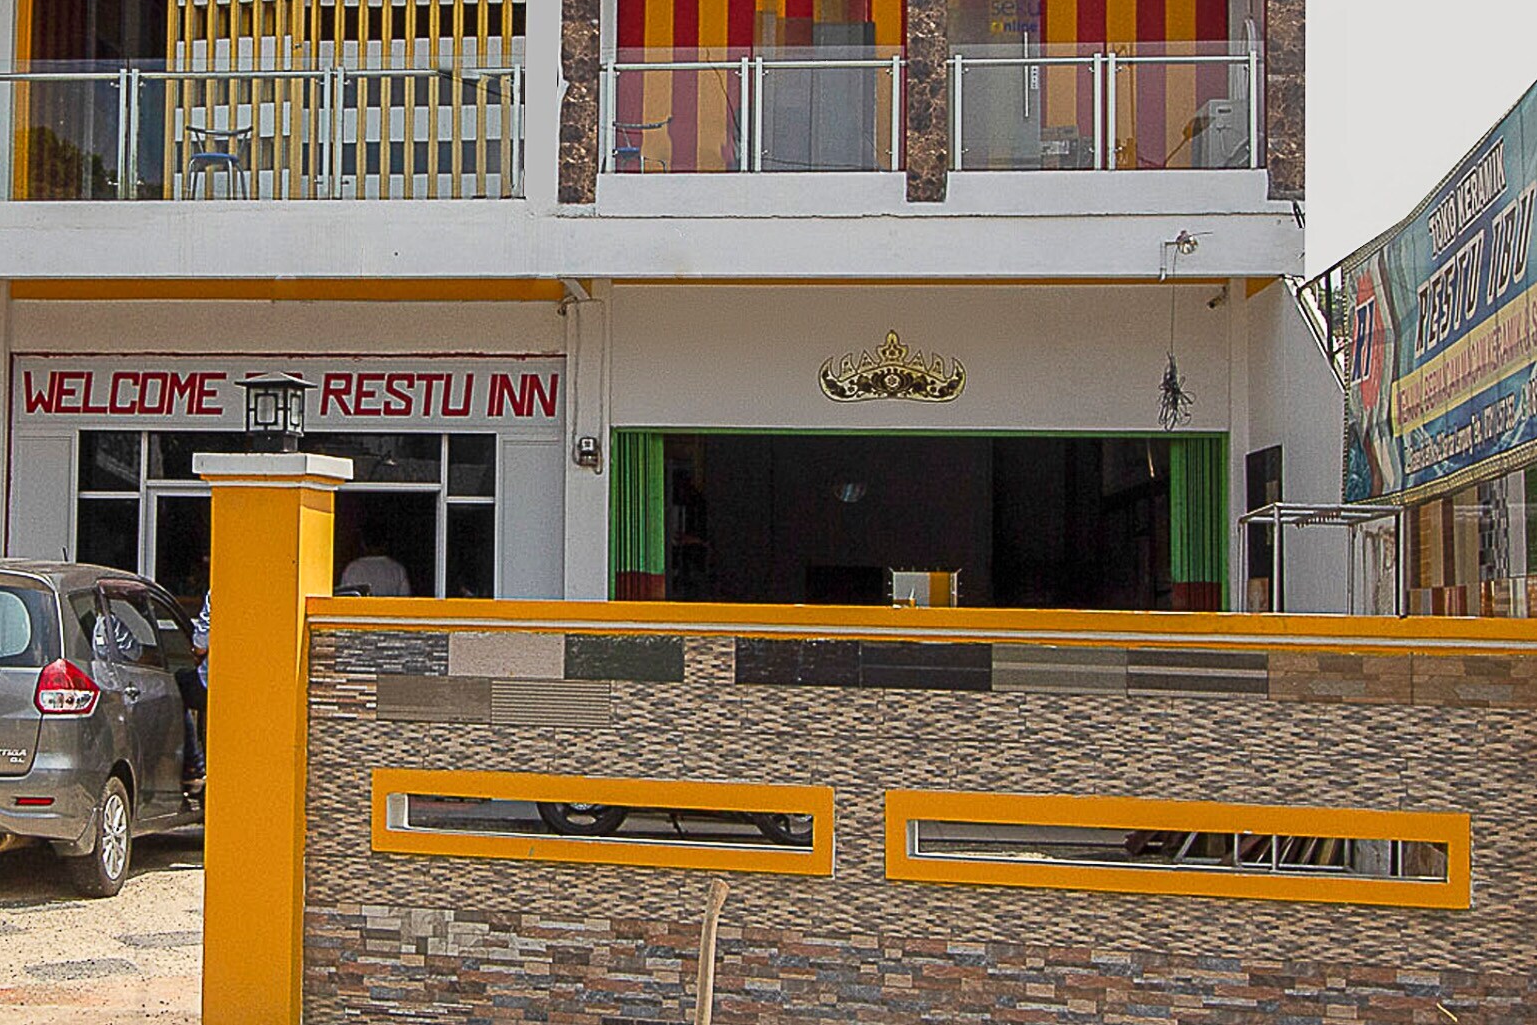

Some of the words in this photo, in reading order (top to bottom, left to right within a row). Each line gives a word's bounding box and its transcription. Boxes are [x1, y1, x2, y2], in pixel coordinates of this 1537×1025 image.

[1428, 188, 1458, 260] TOKO
[1456, 136, 1508, 236] KERAMIK
[1415, 230, 1485, 360] RESTU
[1487, 181, 1536, 305] IBU
[23, 370, 226, 416] WELCOME
[319, 372, 473, 417] RESTU
[486, 372, 559, 418] INN
